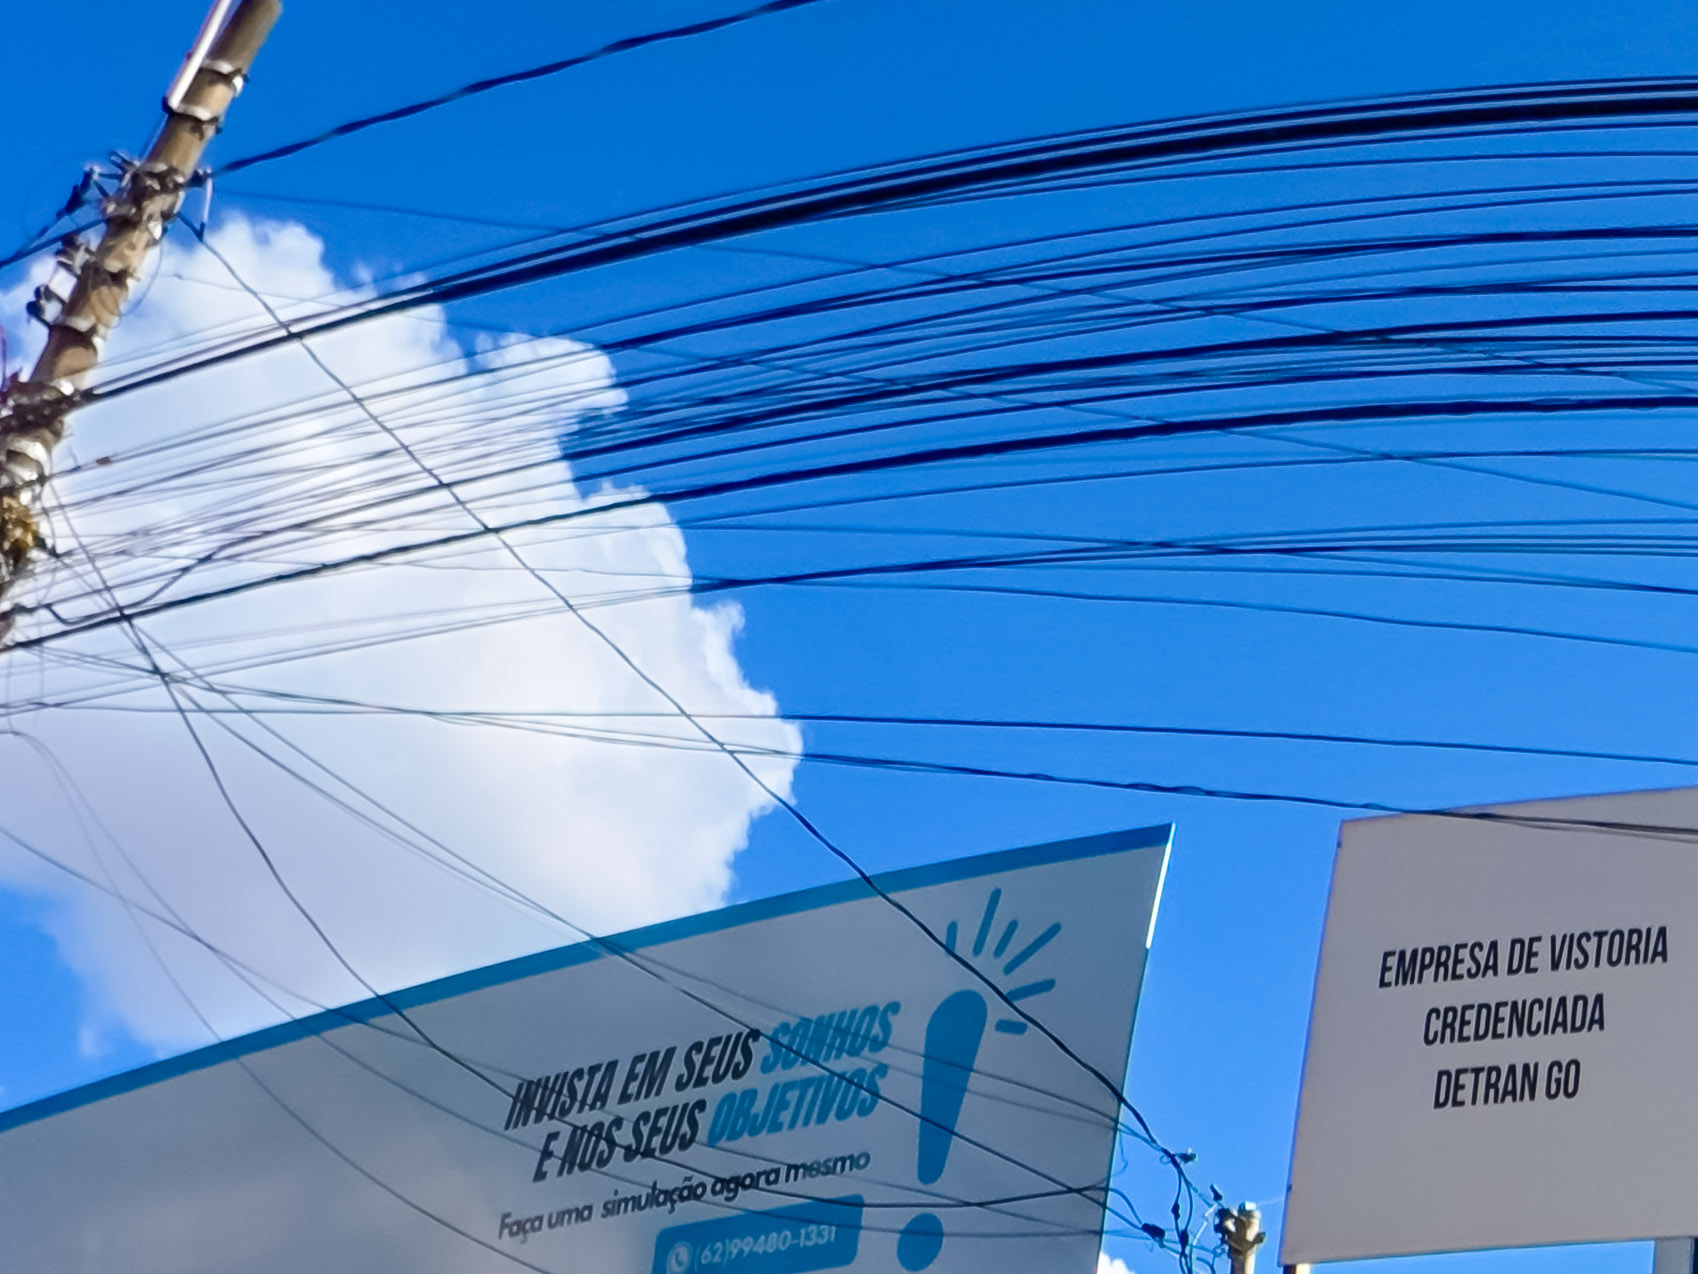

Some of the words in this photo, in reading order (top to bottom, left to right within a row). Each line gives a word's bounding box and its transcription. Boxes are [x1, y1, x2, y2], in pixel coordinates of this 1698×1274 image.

[1378, 939, 1499, 989] EMPRESA
[1506, 936, 1543, 976] DE
[1549, 926, 1668, 971] VISTORIA
[1423, 993, 1606, 1046] CREDENCIADA
[504, 1060, 619, 1132] INVISTA
[617, 1046, 677, 1106] EM
[675, 1029, 760, 1093] SEUS
[760, 1001, 901, 1075] SONHOS
[1433, 1062, 1539, 1110] DETRAN
[1544, 1058, 1581, 1101] GO
[532, 1131, 560, 1183] E
[557, 1116, 623, 1180] NOS
[624, 1099, 707, 1162] SEUS
[706, 1063, 890, 1148] OBJETIVOS
[499, 1212, 543, 1245] Faça
[548, 1202, 593, 1230] uma
[600, 1174, 707, 1214] simulação
[711, 1164, 780, 1201] agora
[785, 1151, 872, 1183] mesmo
